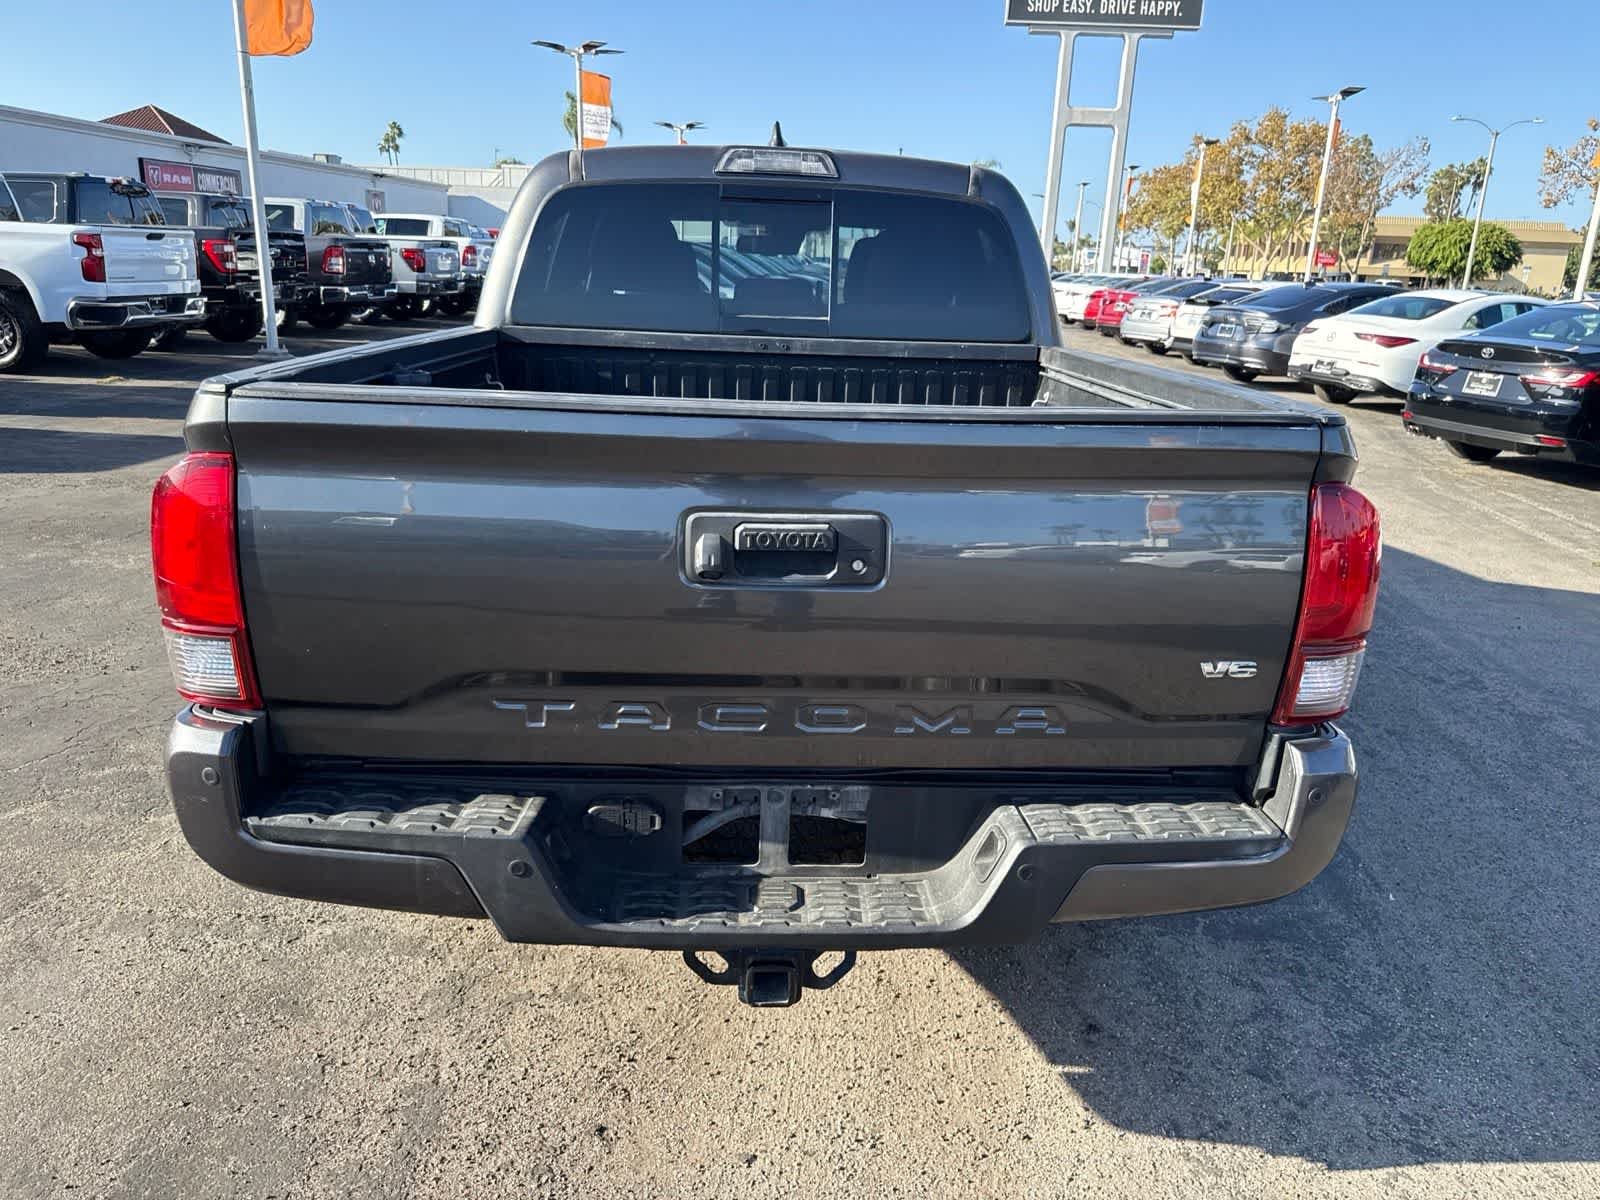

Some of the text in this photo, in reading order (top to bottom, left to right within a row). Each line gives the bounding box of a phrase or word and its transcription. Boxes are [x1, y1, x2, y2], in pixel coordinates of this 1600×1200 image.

[1027, 0, 1183, 17] SHOP EASY. DRIVE HAPPY.
[163, 173, 192, 185] RAM
[197, 172, 237, 194] COMMERCIAL
[743, 531, 826, 549] TOYOTA
[1200, 661, 1258, 678] V6
[494, 700, 1067, 734] TACOMA
